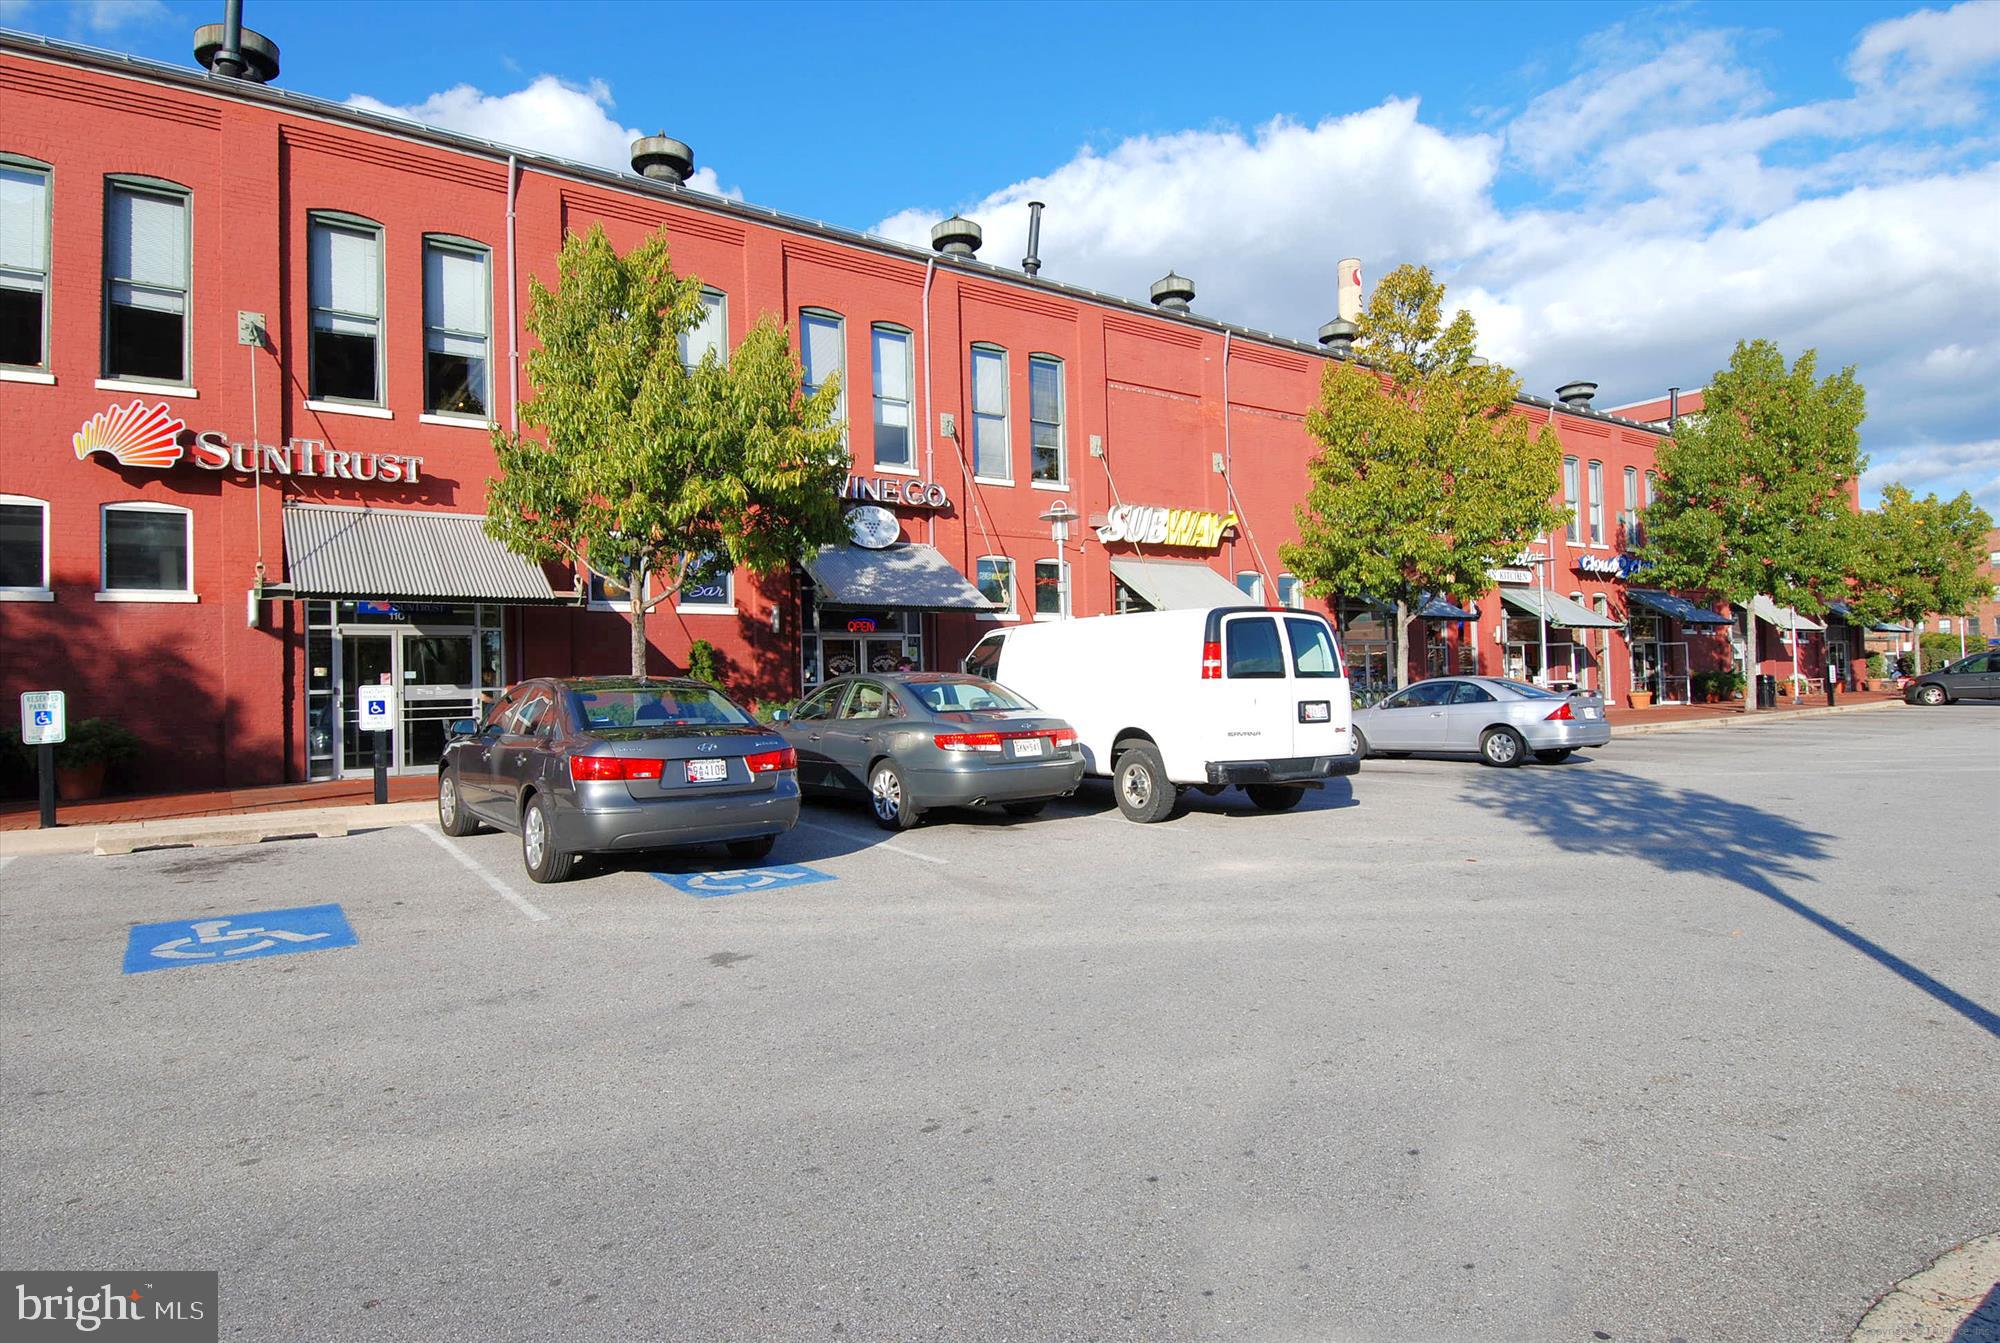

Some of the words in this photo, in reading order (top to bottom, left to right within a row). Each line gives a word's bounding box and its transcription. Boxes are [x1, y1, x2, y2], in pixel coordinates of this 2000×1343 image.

[1096, 503, 1239, 548] SUBWAY
[1582, 555, 1620, 573] Cloud
[847, 621, 876, 633] OPEN
